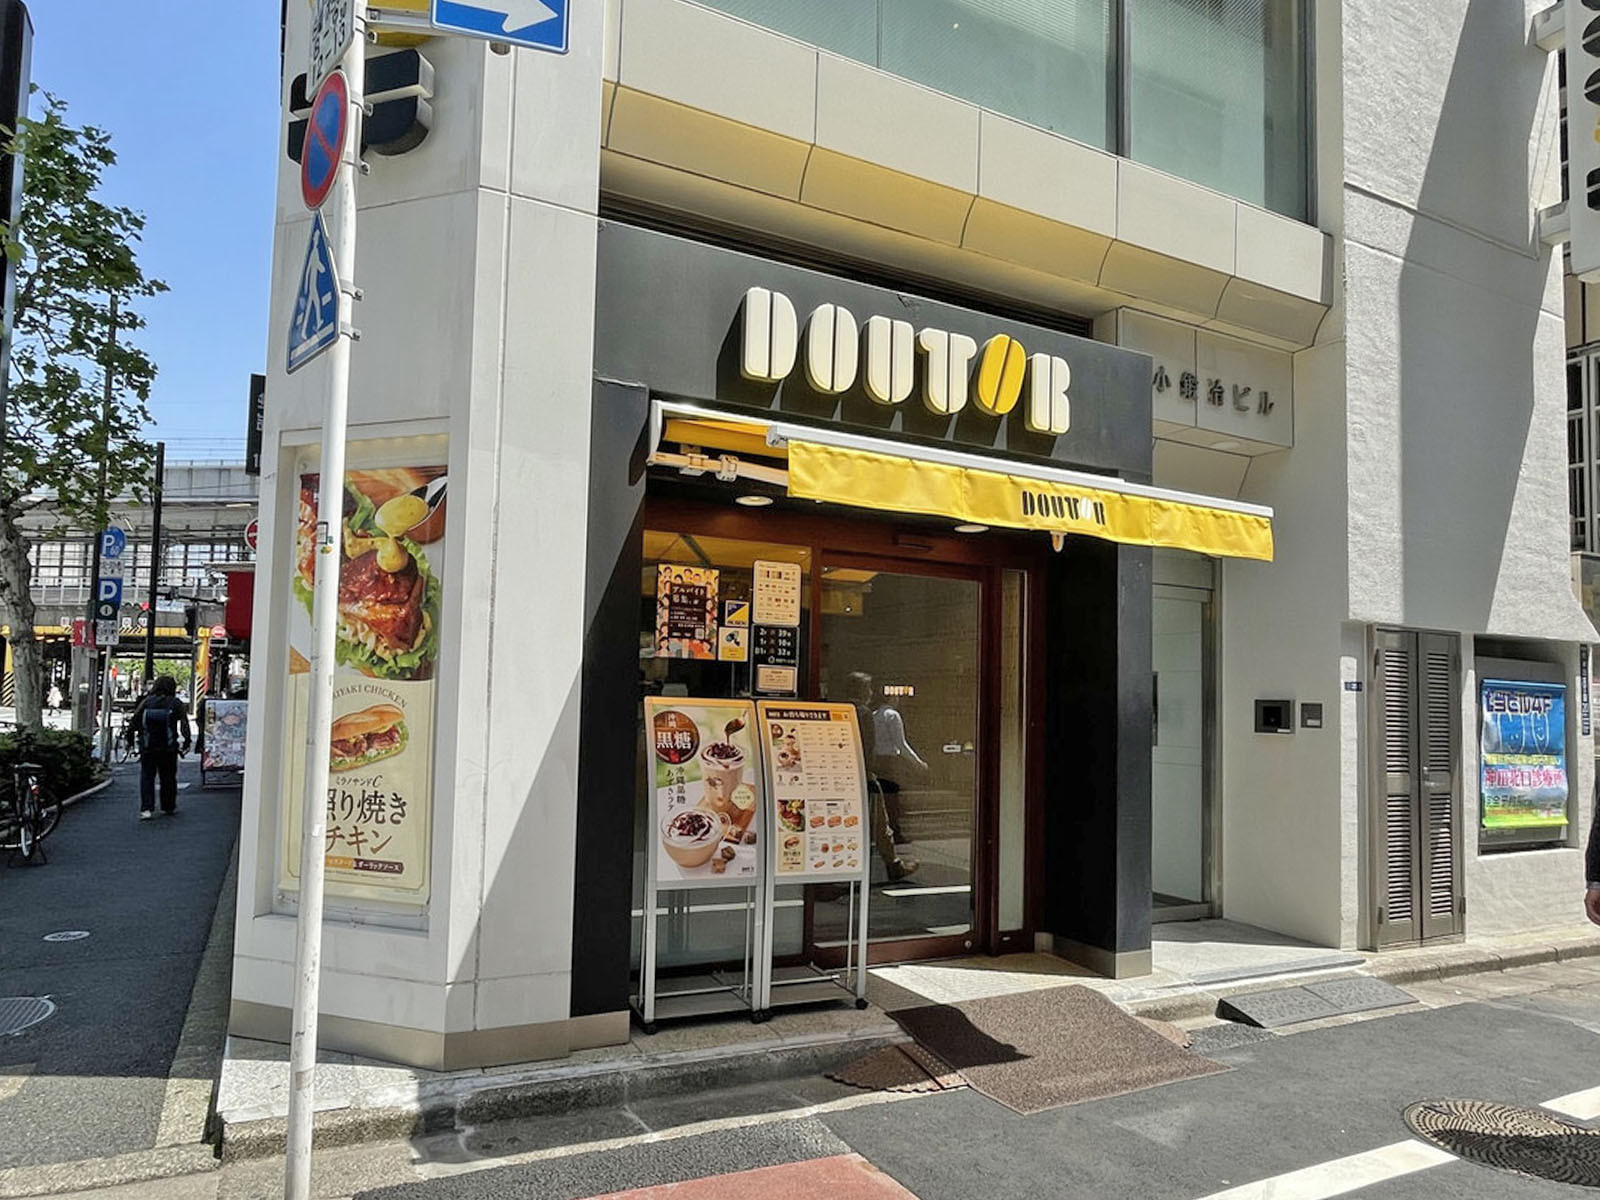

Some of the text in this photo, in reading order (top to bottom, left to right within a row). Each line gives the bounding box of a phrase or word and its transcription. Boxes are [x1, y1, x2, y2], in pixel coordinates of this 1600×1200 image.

[742, 286, 1071, 434] DOUTOR
[1022, 490, 1105, 525] DOUTOR
[99, 580, 117, 601] P
[363, 684, 408, 708] CHICKEN
[657, 731, 691, 750] 黒糖
[325, 825, 393, 857] チキン
